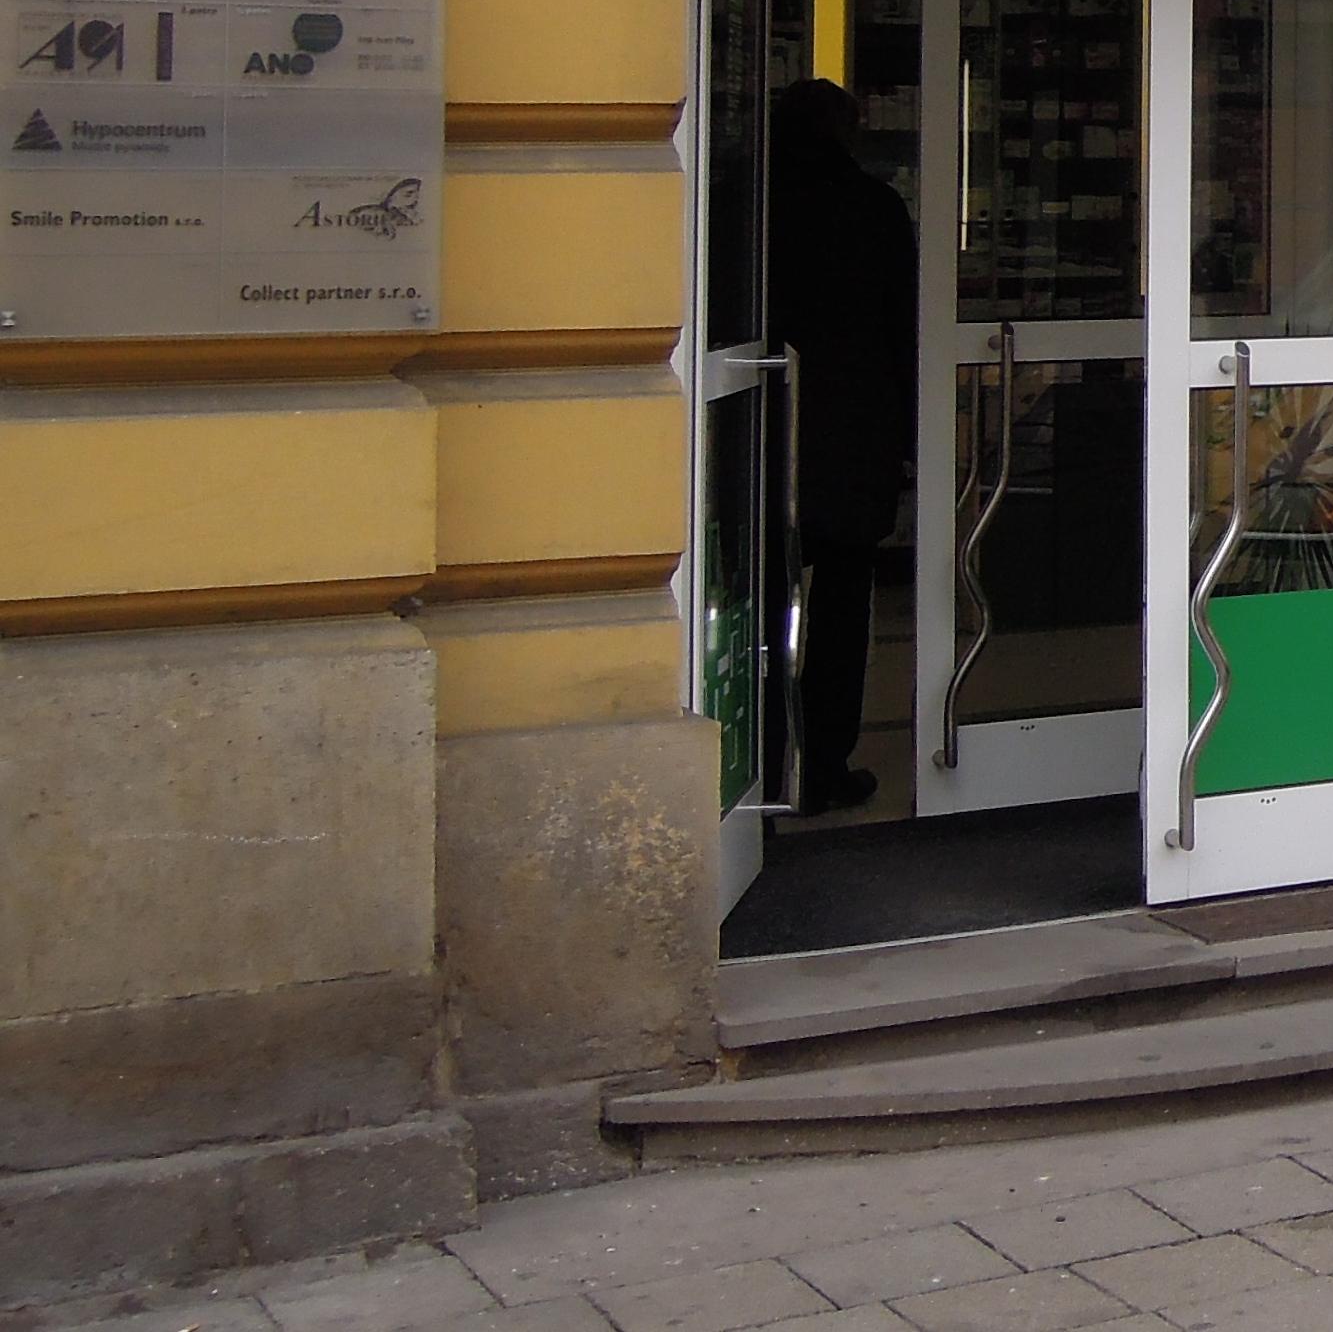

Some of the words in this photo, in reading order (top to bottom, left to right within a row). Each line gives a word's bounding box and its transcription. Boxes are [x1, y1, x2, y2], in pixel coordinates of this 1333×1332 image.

[72, 120, 207, 139] Hypocentrum
[11, 210, 64, 227] Smile
[70, 211, 169, 227] Promotion
[240, 285, 300, 301] Collect
[306, 286, 372, 304] partner
[378, 286, 422, 299] s.r.o.
